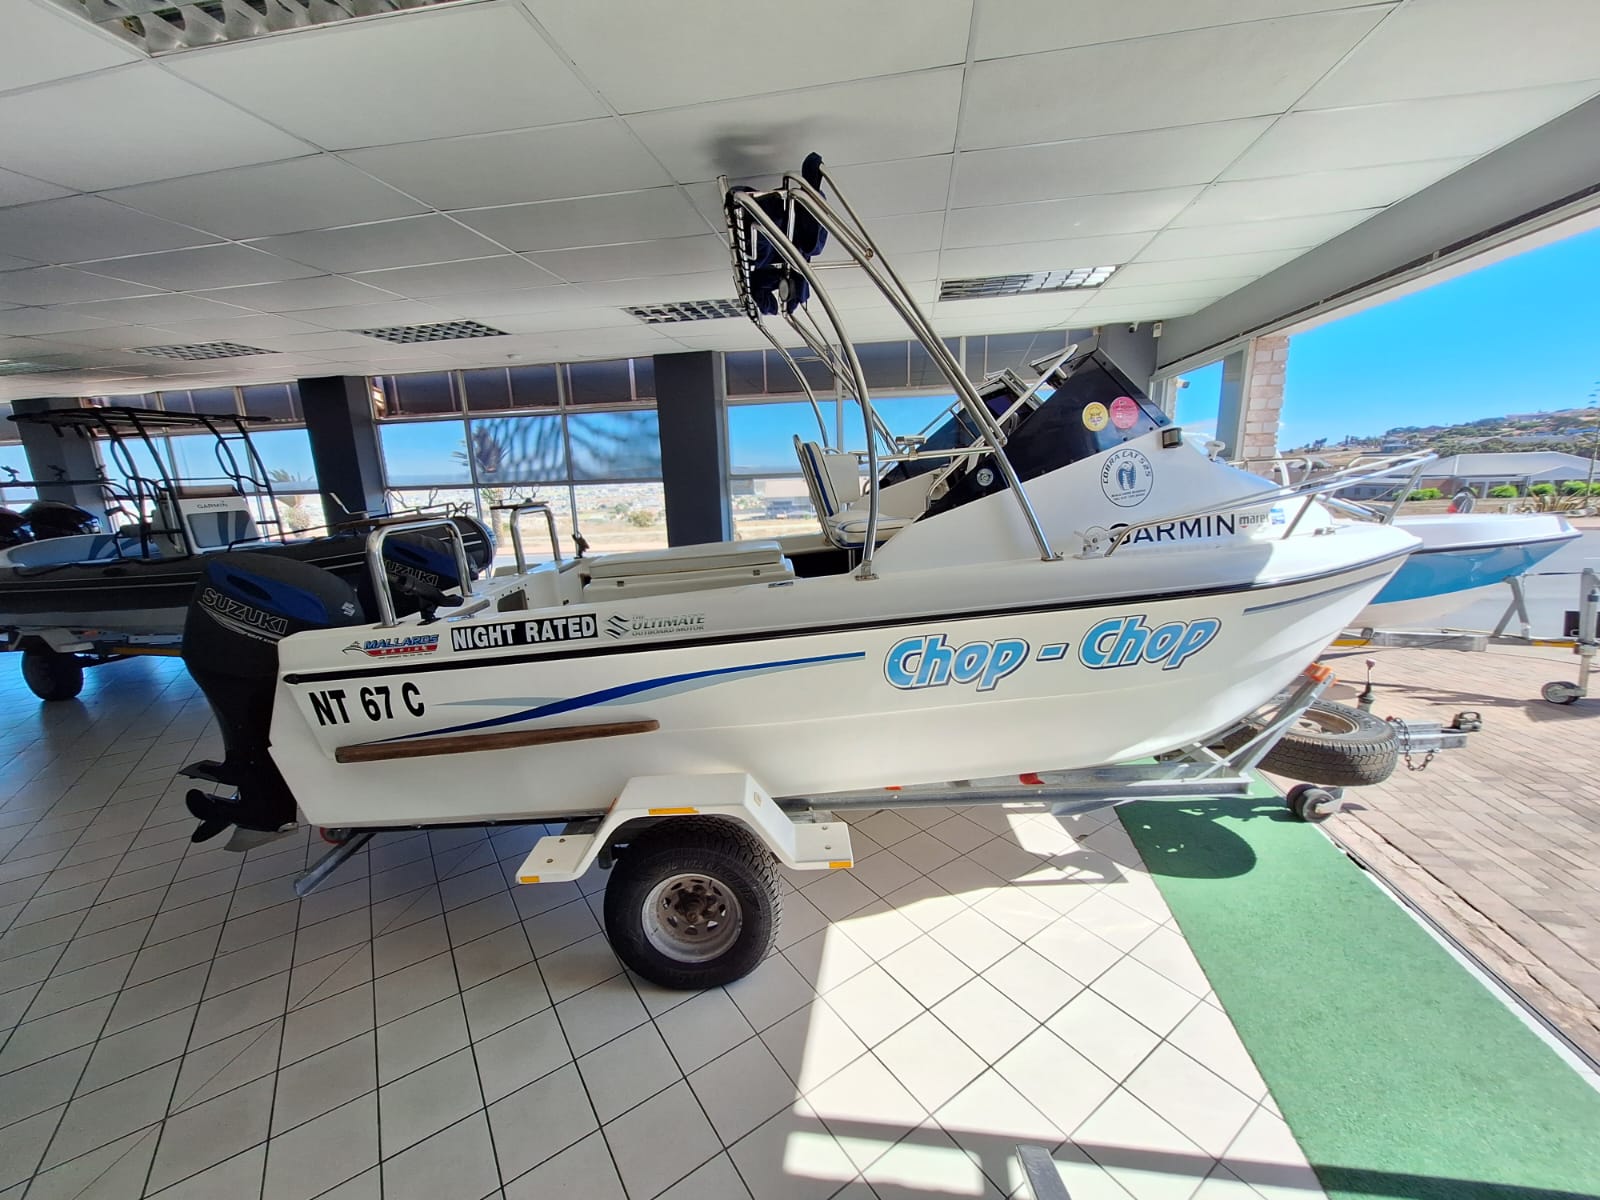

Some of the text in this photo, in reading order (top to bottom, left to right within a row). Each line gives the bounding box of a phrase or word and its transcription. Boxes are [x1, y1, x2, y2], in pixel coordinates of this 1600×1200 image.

[383, 560, 439, 587] UZUKI
[202, 587, 289, 635] SUZUKI
[631, 614, 705, 631] ULTIMATE
[364, 633, 440, 650] MALLARDS
[452, 616, 596, 650] NIGHT RATED
[883, 633, 1030, 692] Chop
[1078, 614, 1222, 672] Chop
[308, 682, 425, 726] NT 67 C
